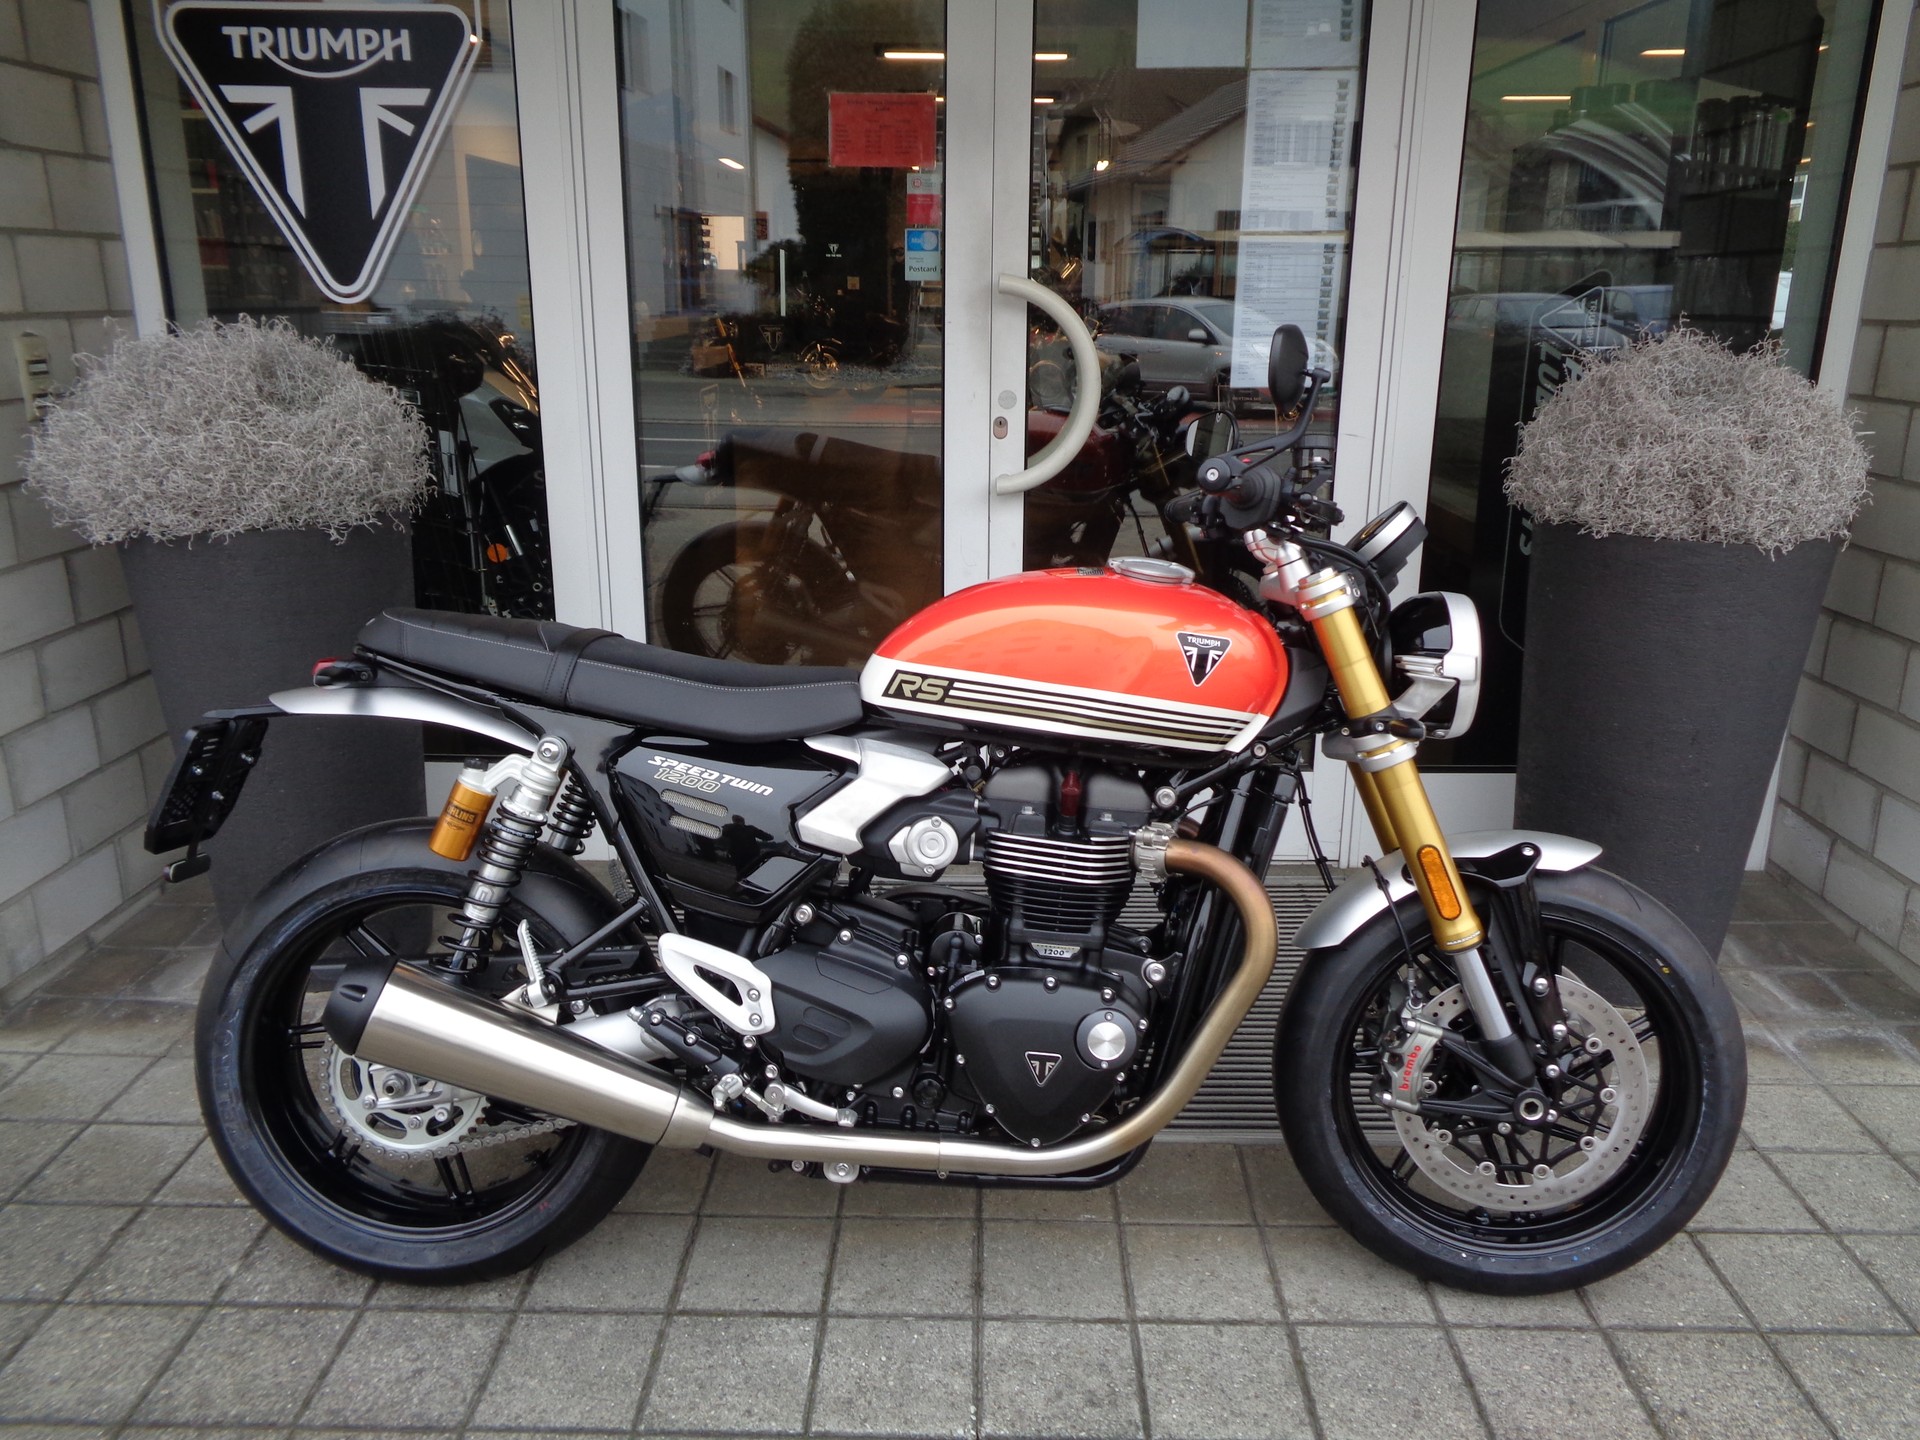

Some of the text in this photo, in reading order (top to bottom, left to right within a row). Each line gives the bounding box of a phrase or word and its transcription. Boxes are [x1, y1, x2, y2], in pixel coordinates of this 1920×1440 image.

[221, 26, 412, 77] TRIUMPH
[909, 265, 937, 273] Postcard
[1187, 636, 1221, 648] TRIUMPH
[888, 673, 949, 701] RS
[647, 755, 774, 796] SPEED TWIN
[654, 768, 720, 793] 1200
[1043, 948, 1065, 956] 1200
[1398, 1045, 1422, 1091] brembo
